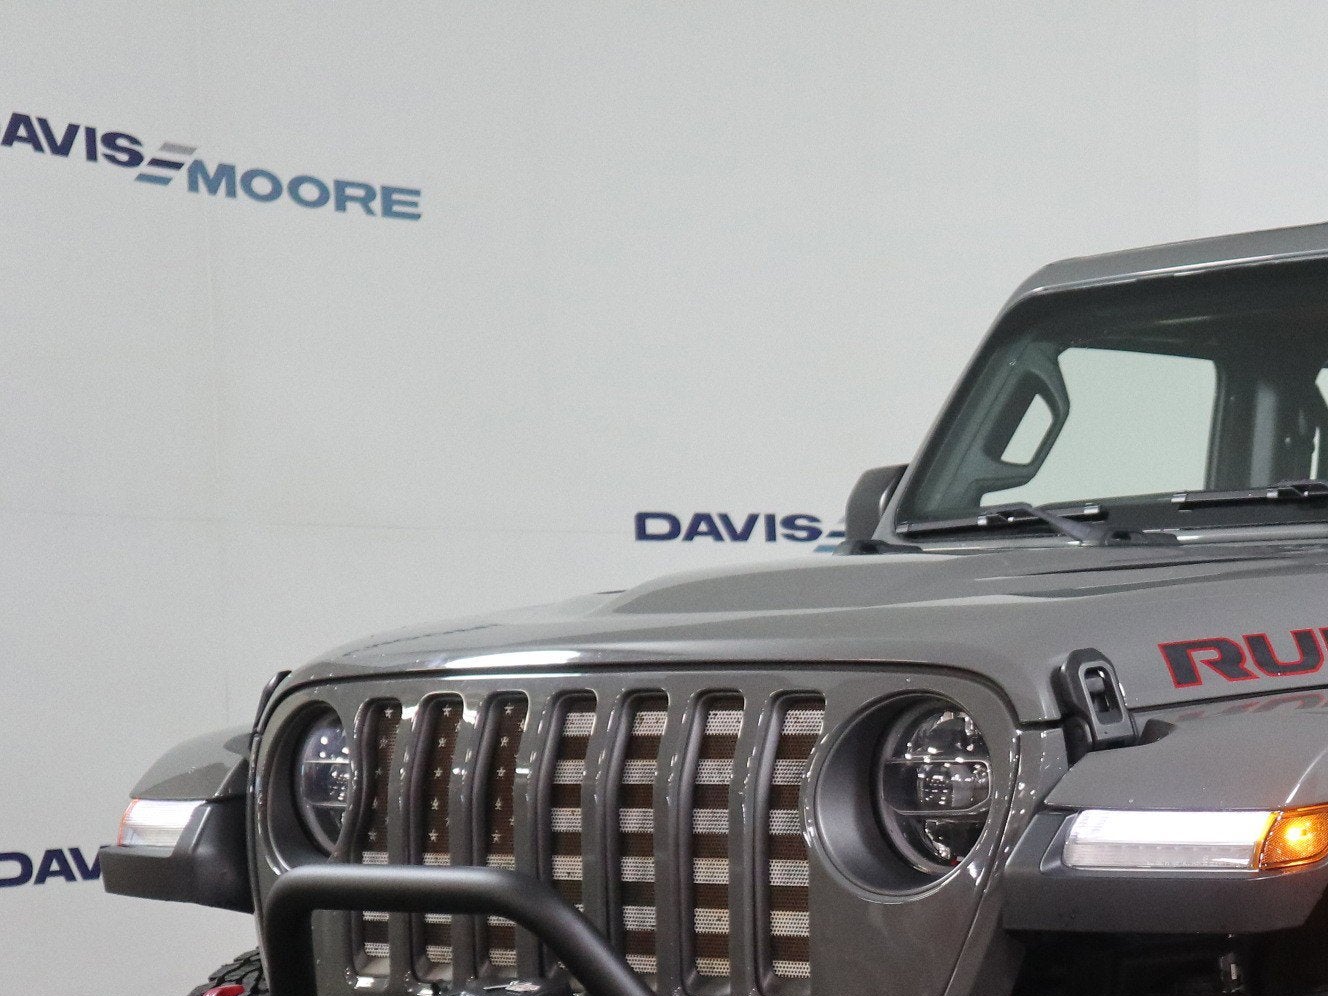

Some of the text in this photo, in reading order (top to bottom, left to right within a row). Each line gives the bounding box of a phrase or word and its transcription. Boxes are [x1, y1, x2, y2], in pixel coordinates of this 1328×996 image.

[0, 112, 423, 221] AVIS MOORE
[634, 511, 824, 543] DAVIS
